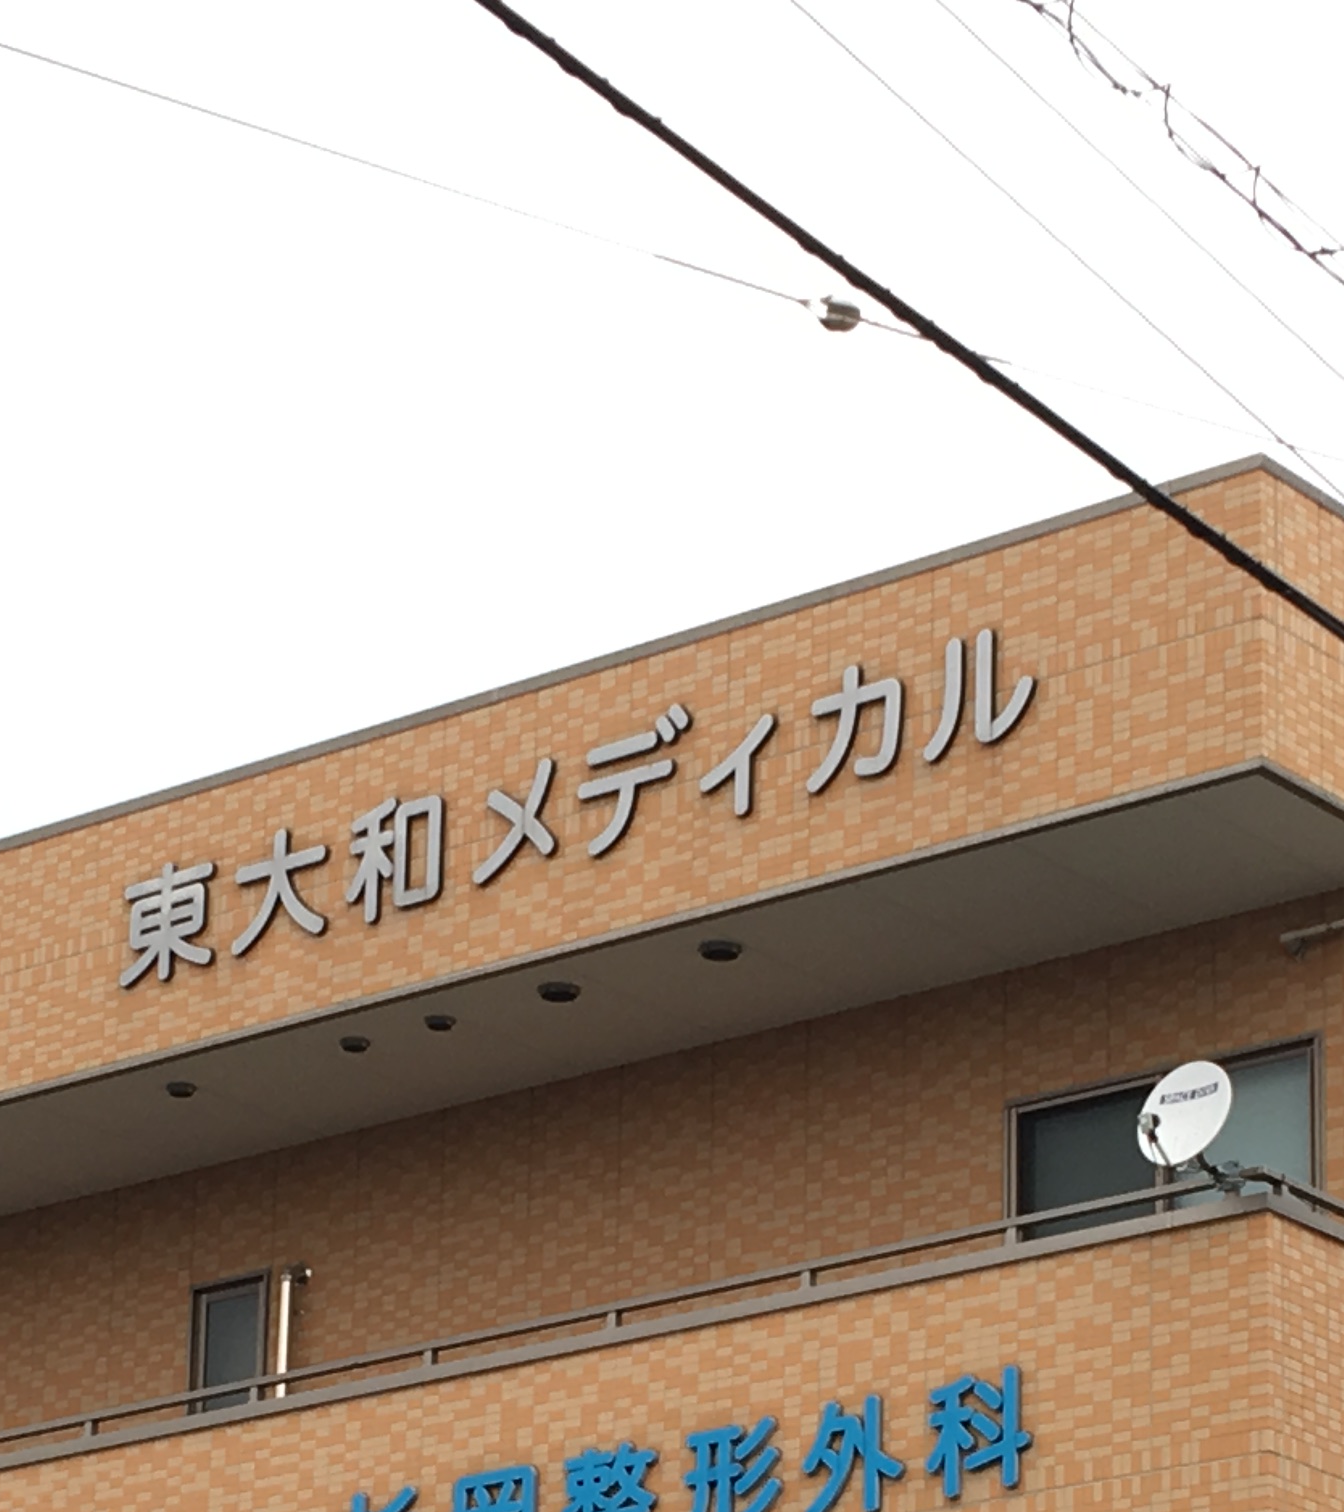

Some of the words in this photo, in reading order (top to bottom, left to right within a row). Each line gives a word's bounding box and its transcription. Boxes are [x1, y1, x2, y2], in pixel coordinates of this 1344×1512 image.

[119, 628, 1037, 988] 東大和メディカル
